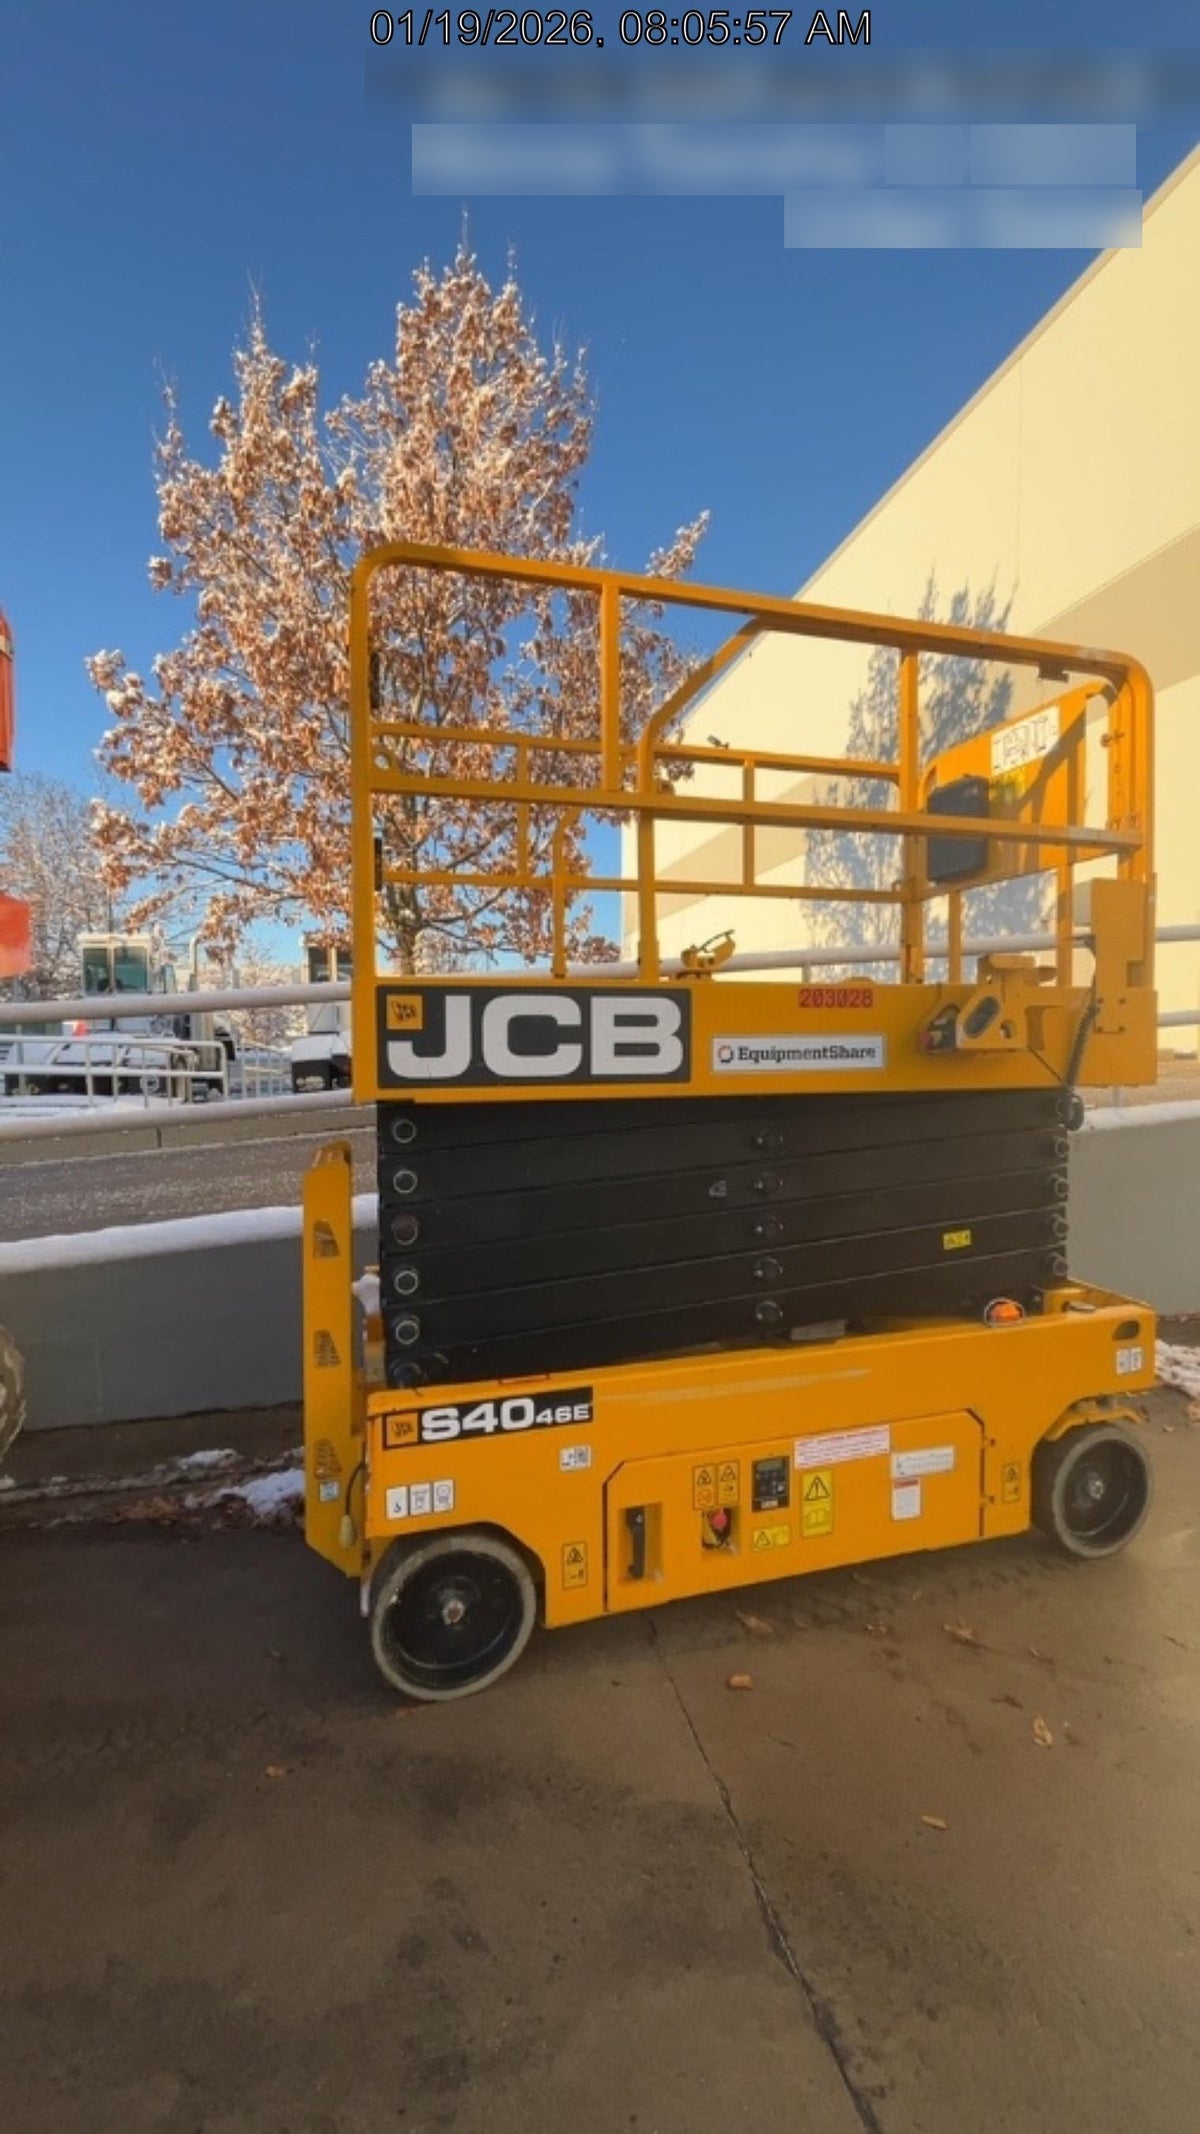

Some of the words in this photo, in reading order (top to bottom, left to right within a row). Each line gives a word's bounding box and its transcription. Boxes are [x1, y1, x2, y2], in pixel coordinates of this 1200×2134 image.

[798, 988, 873, 1009] 203028
[386, 994, 684, 1079] JCB
[737, 1045, 876, 1064] EquipmentShare
